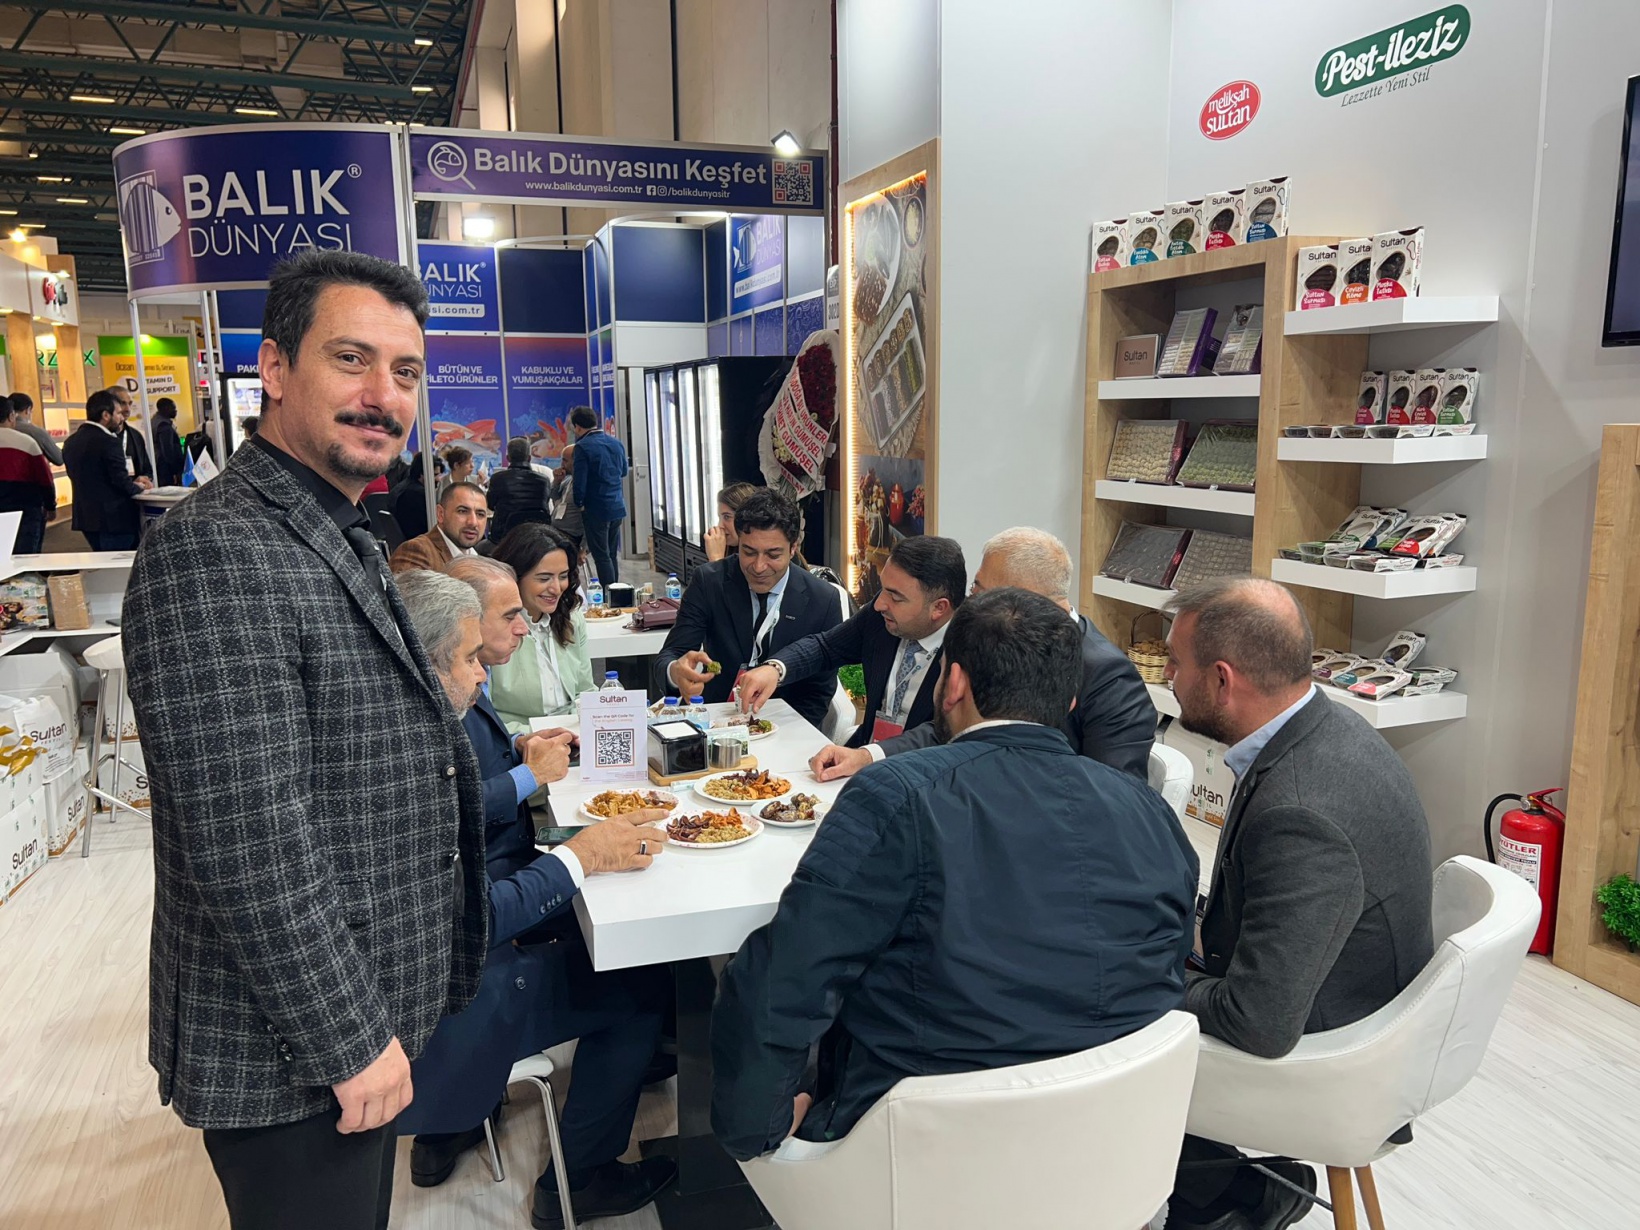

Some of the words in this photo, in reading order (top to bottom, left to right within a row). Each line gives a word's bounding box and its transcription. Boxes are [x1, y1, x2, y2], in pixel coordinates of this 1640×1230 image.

[1321, 15, 1461, 92] Pest-ileziz
[1340, 85, 1383, 107] Lezzette
[1385, 73, 1409, 93] Yeni
[1409, 65, 1433, 87] Stil
[474, 148, 543, 174] Balık
[549, 152, 678, 181] Dünyasını
[685, 159, 767, 188] Keşfet
[525, 181, 643, 194] www.balikdunyasi.com.tr
[1253, 185, 1276, 195] Sultan
[1212, 196, 1235, 205] Sultan
[1171, 206, 1194, 215] Sultan
[1135, 216, 1157, 224] Sultan
[1099, 225, 1119, 233] Sultan
[187, 218, 352, 257] DÜNYASI
[1380, 237, 1406, 248] Sultan
[1308, 252, 1337, 261] Sultan
[423, 281, 482, 298] NYASI
[428, 306, 480, 315] si.com.tr
[1123, 350, 1148, 361] Sultan
[438, 364, 471, 374] BÜTÜN
[471, 365, 483, 374] VE
[521, 366, 561, 375] KABUKLU
[562, 366, 575, 375] VE
[456, 374, 498, 384] ÜRÜNLER
[512, 376, 584, 385] YUMUŞAKÇALAR
[1419, 374, 1439, 382] Sultan
[1448, 373, 1469, 381] Sultan
[126, 378, 139, 392] D
[599, 695, 627, 704] Sultan
[30, 722, 68, 743] Sultan
[1190, 784, 1224, 807] ultan
[67, 795, 85, 822] Sultan
[12, 838, 38, 870] Sultan
